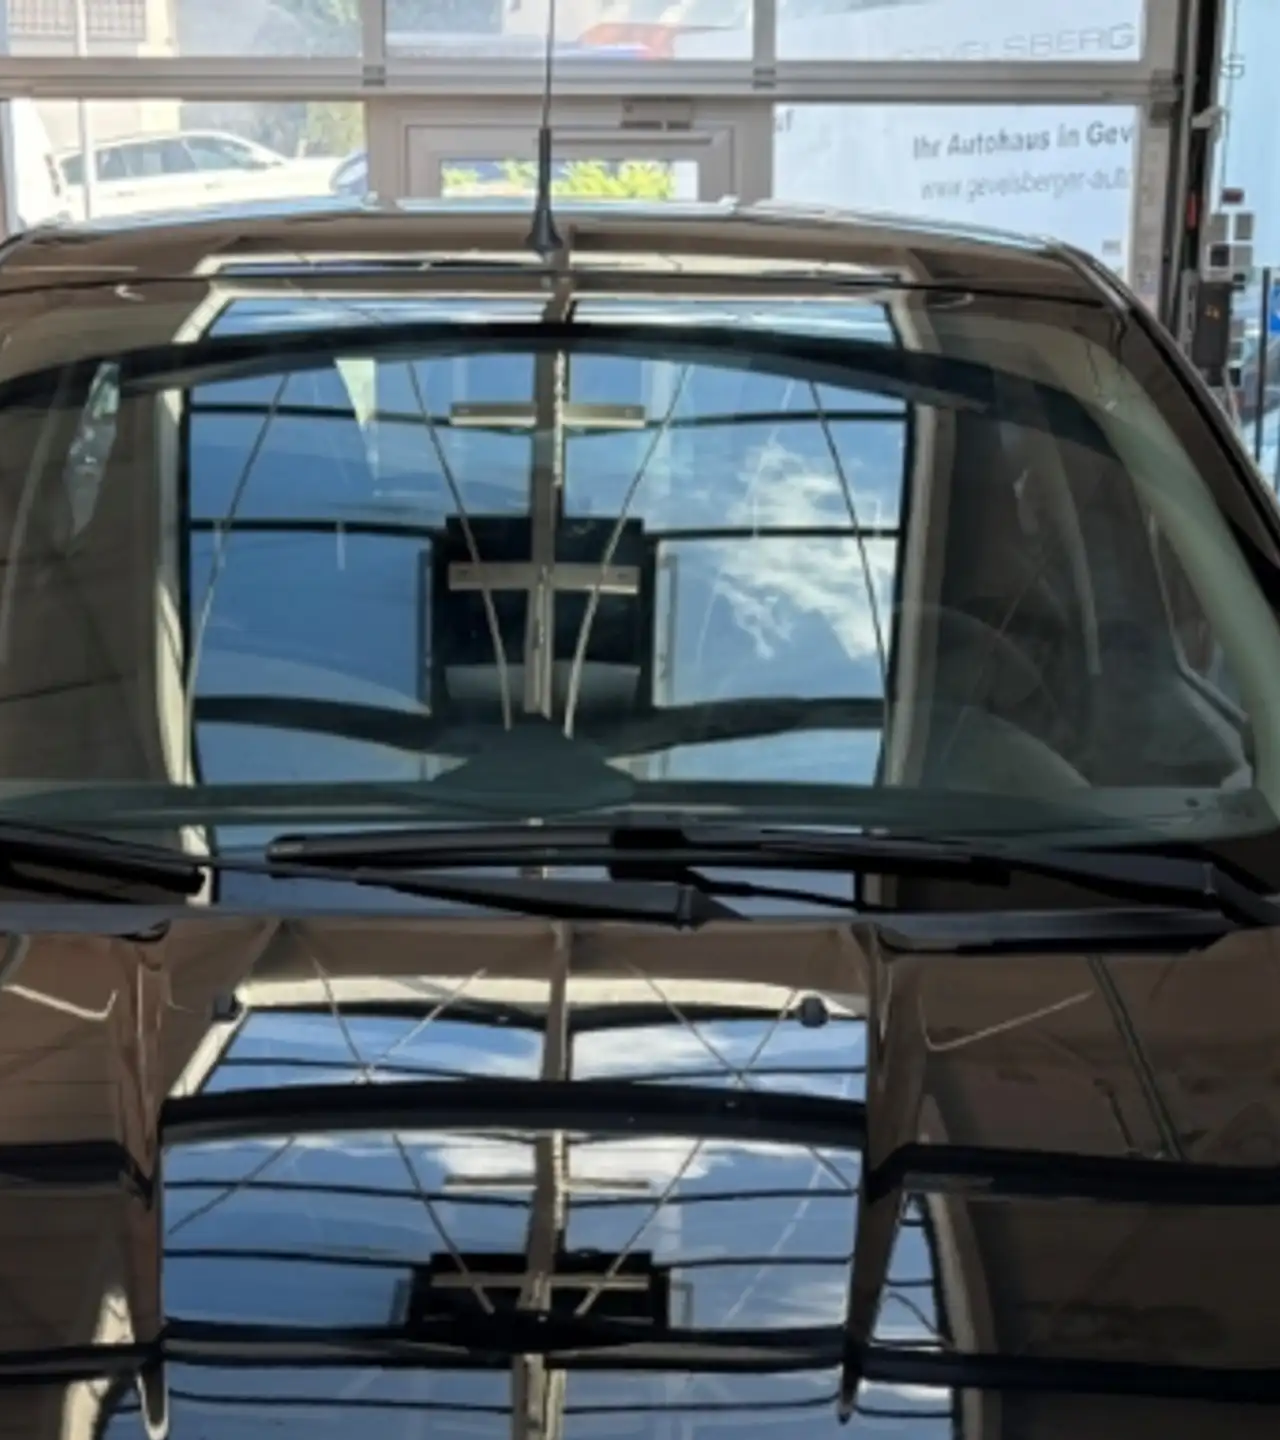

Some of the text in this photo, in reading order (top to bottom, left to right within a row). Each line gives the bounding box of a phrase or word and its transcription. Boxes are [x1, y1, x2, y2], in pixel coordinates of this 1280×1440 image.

[913, 134, 942, 160] Ihr
[947, 126, 1051, 157] Autohaus
[1056, 122, 1080, 148] in
